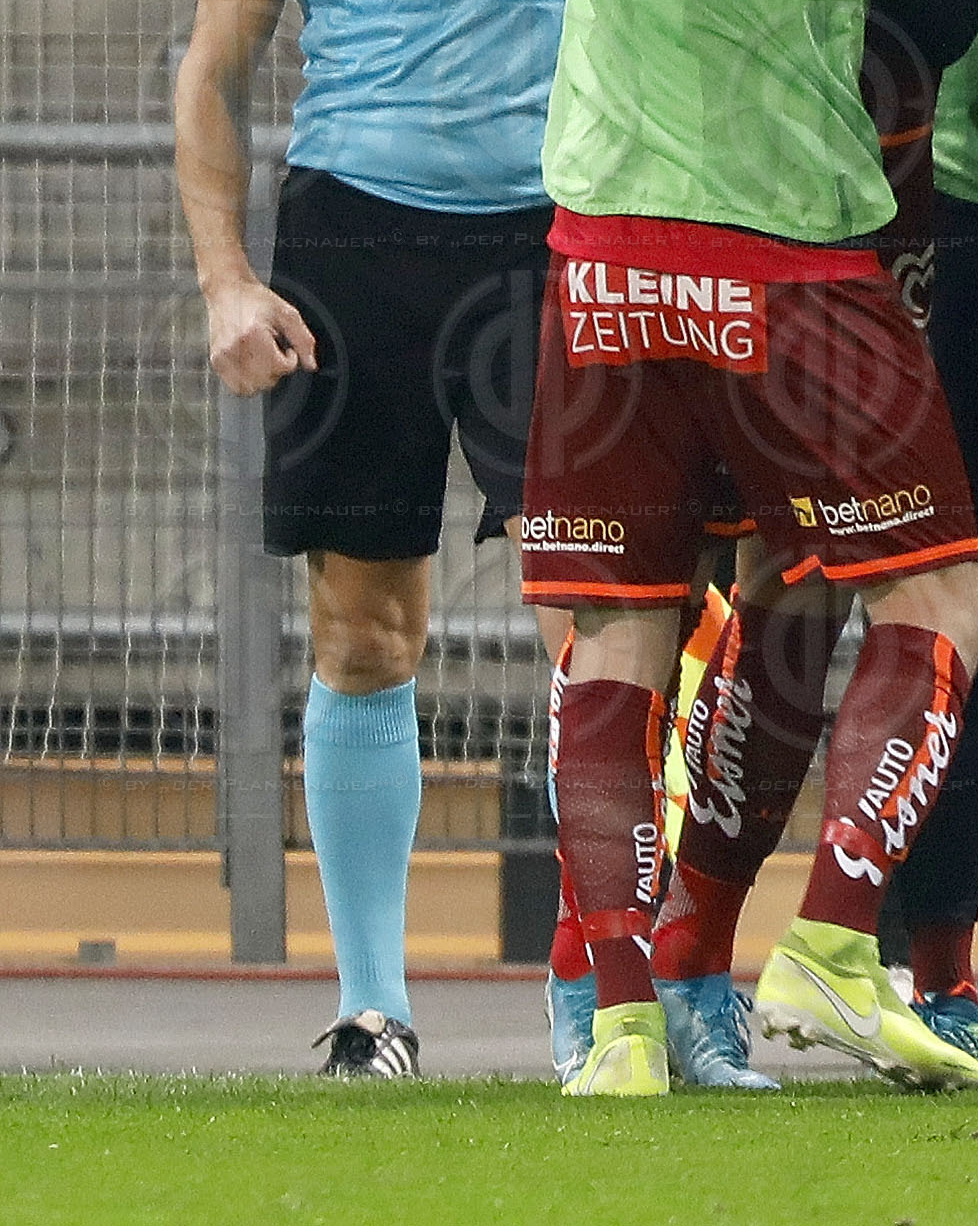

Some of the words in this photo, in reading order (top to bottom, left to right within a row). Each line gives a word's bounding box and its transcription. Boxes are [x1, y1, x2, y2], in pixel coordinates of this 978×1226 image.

[567, 261, 753, 313] KLEINE
[569, 310, 754, 360] ZEITUNG
[819, 485, 932, 525] betnano
